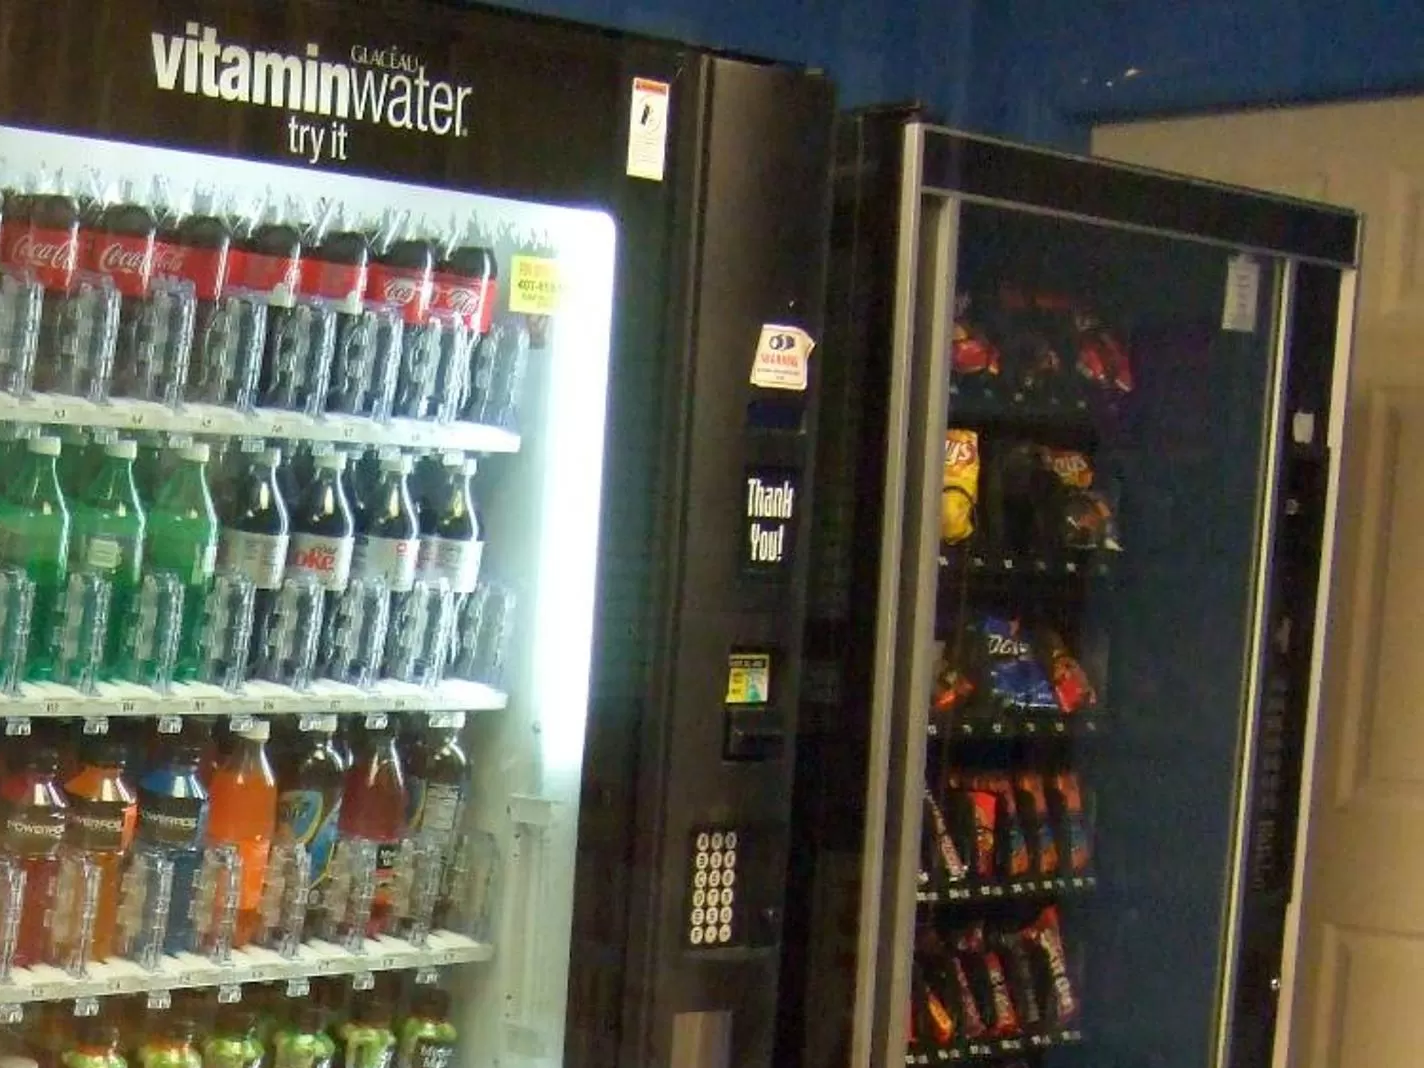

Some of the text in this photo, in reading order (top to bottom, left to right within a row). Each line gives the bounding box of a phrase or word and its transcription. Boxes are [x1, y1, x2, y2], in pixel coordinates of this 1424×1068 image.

[151, 20, 473, 137] vitaminwater
[288, 116, 349, 164] try it
[747, 477, 794, 518] Thank
[750, 523, 785, 561] You!
